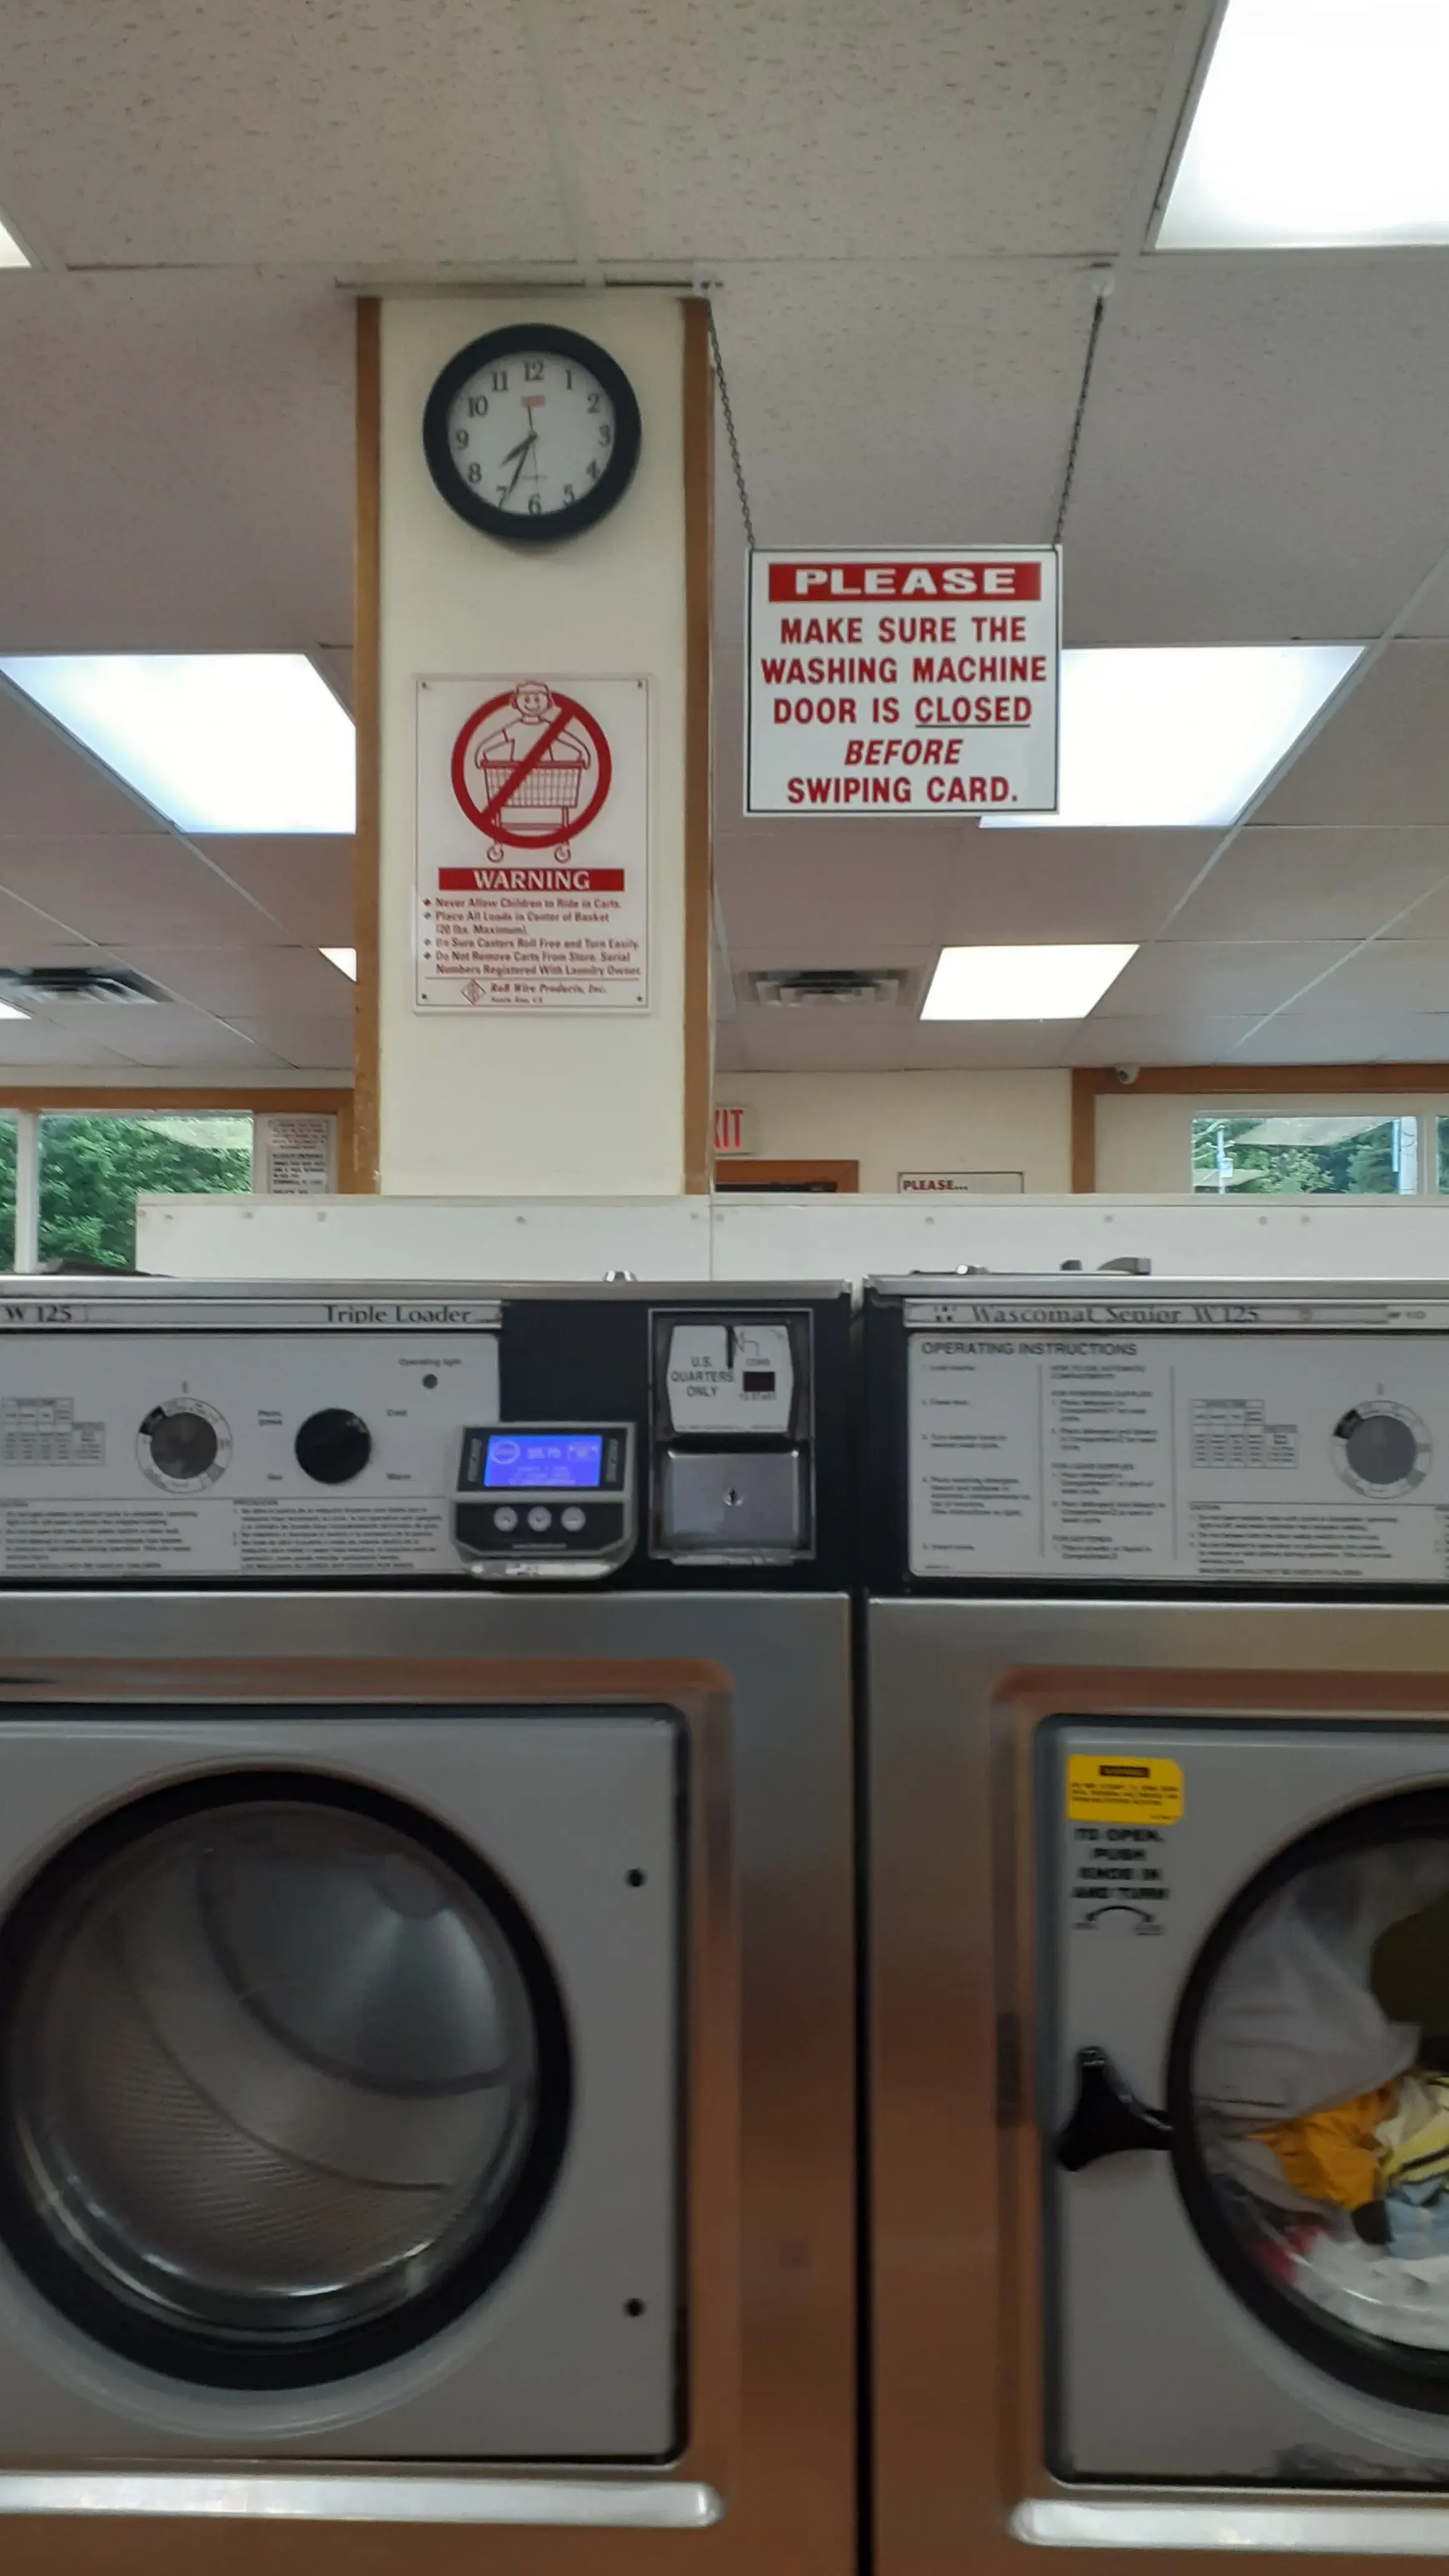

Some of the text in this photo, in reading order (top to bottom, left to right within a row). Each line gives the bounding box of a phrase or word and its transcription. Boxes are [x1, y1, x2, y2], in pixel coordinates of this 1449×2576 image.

[492, 371, 509, 392] 11
[524, 360, 544, 382] 12
[565, 369, 573, 390] 1
[468, 394, 489, 417] 10
[587, 393, 601, 414] 2
[455, 429, 469, 450] 9
[598, 424, 611, 447] 3
[468, 461, 482, 484] 8
[586, 459, 601, 479] 4
[496, 485, 509, 507] 7
[527, 493, 542, 515] 6
[563, 484, 575, 507] 5
[796, 568, 1015, 595] PLEASE
[780, 616, 1027, 644] MAKE SURE THE
[760, 656, 1047, 684] WASHING MACHINE
[774, 696, 1032, 724] DOOR IS CLOSED
[844, 739, 964, 766] BEFORE
[787, 776, 1018, 804] SWIPING CARD.
[472, 870, 590, 890] WARNING
[436, 898, 465, 908] Never
[469, 898, 497, 908] Allow
[500, 899, 542, 909] Children
[544, 900, 554, 909] to
[557, 899, 579, 909] Ride
[581, 899, 592, 909] in
[436, 911, 610, 922] Place All Loads in Center of Basket
[452, 938, 475, 948] Sure
[477, 938, 515, 948] Casters
[517, 938, 537, 948] Roll
[539, 939, 561, 949] Free
[564, 939, 582, 948] and
[584, 939, 607, 949] Turn
[436, 951, 450, 961] Do
[451, 951, 471, 961] Not
[472, 951, 510, 962] Remove
[514, 952, 540, 962] Carts
[542, 952, 567, 962] From
[600, 952, 631, 962] Serial
[436, 964, 481, 975] Numbers
[483, 965, 537, 976] Registered
[539, 965, 563, 975] With
[565, 965, 604, 976] Laundry
[514, 984, 536, 993] Wire
[715, 1109, 744, 1149] XIT
[3, 1304, 72, 1323] W 125
[324, 1304, 472, 1324] Triple Loader
[971, 1304, 1259, 1324] Wascomat Senior W 125
[921, 1342, 1138, 1356] OPERATING INSTRUCTIONS
[691, 1355, 713, 1367] U.S.
[670, 1370, 735, 1383] QUARTERS
[686, 1385, 720, 1397] ONLY
[1074, 1828, 1099, 1840] TO
[1090, 1848, 1148, 1861] PUSH
